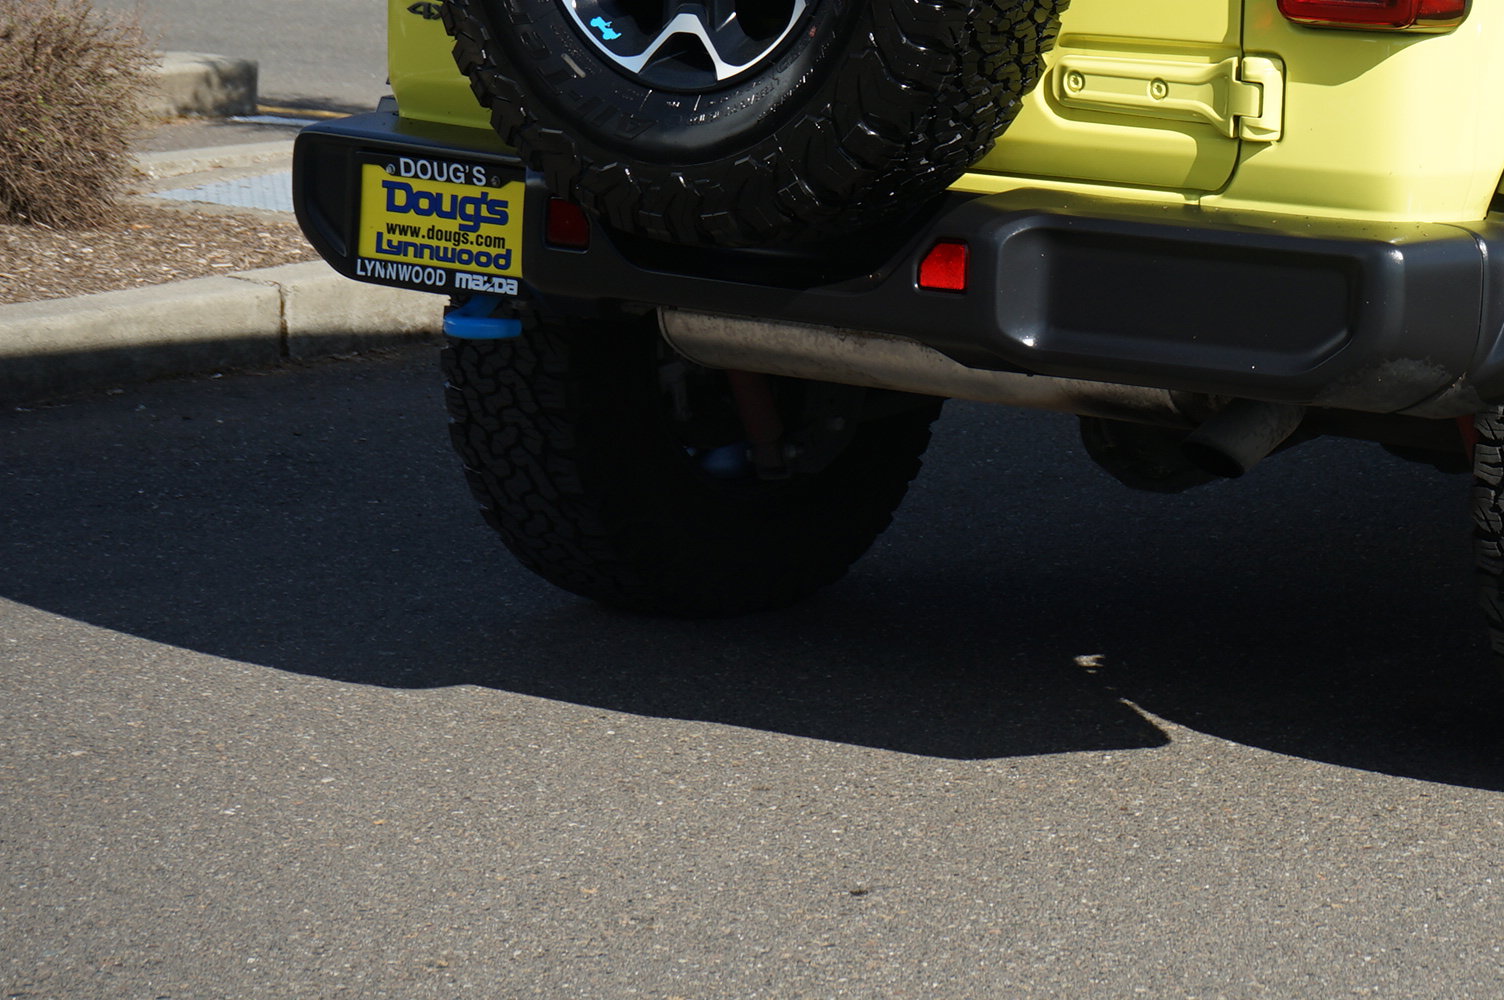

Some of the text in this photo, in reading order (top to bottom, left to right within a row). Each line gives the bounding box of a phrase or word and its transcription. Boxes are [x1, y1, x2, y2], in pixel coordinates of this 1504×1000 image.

[400, 157, 487, 186] DOUG'S
[382, 179, 510, 233] Doug's
[375, 232, 512, 270] Lynnwood
[386, 220, 506, 250] www.dougs.com
[356, 258, 518, 295] LYNNWOOD mazda
